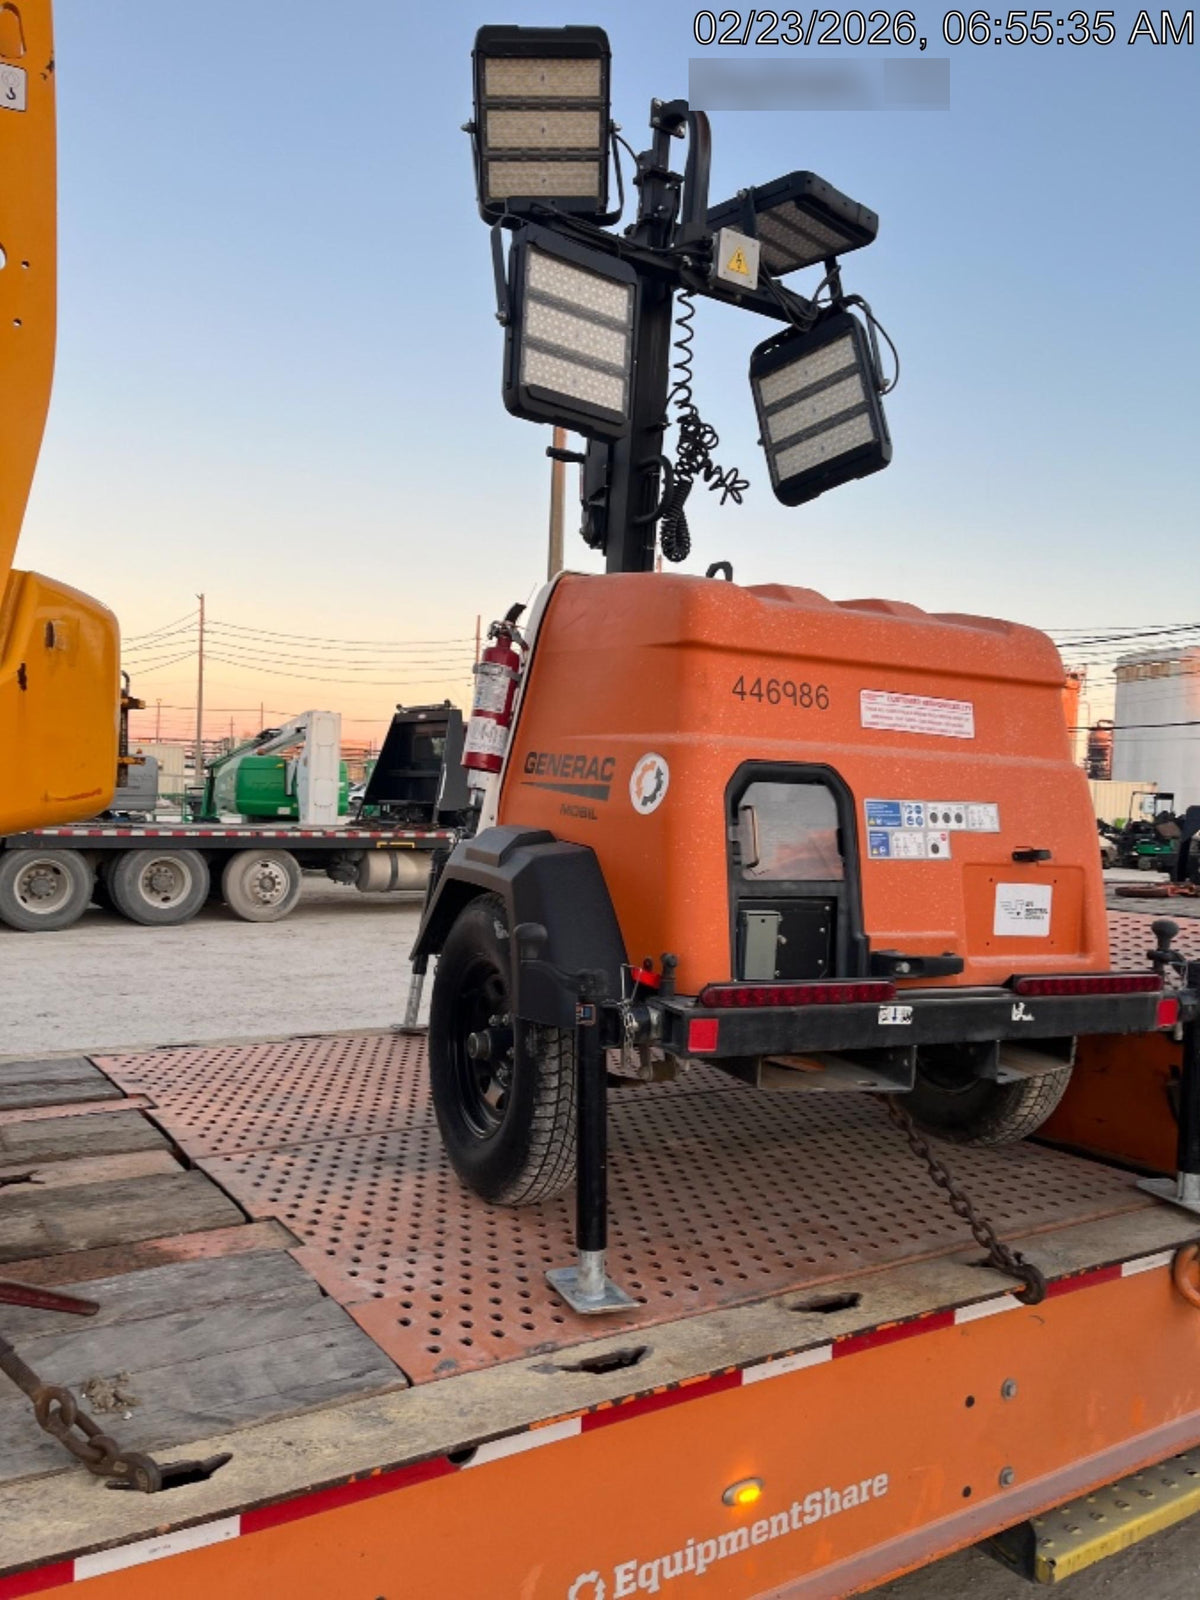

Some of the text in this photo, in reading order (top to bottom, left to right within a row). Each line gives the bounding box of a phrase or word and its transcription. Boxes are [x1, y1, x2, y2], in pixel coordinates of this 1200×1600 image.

[731, 675, 830, 710] 446986
[524, 751, 616, 782] GENERAC
[613, 1472, 889, 1599] EquipmentShare
